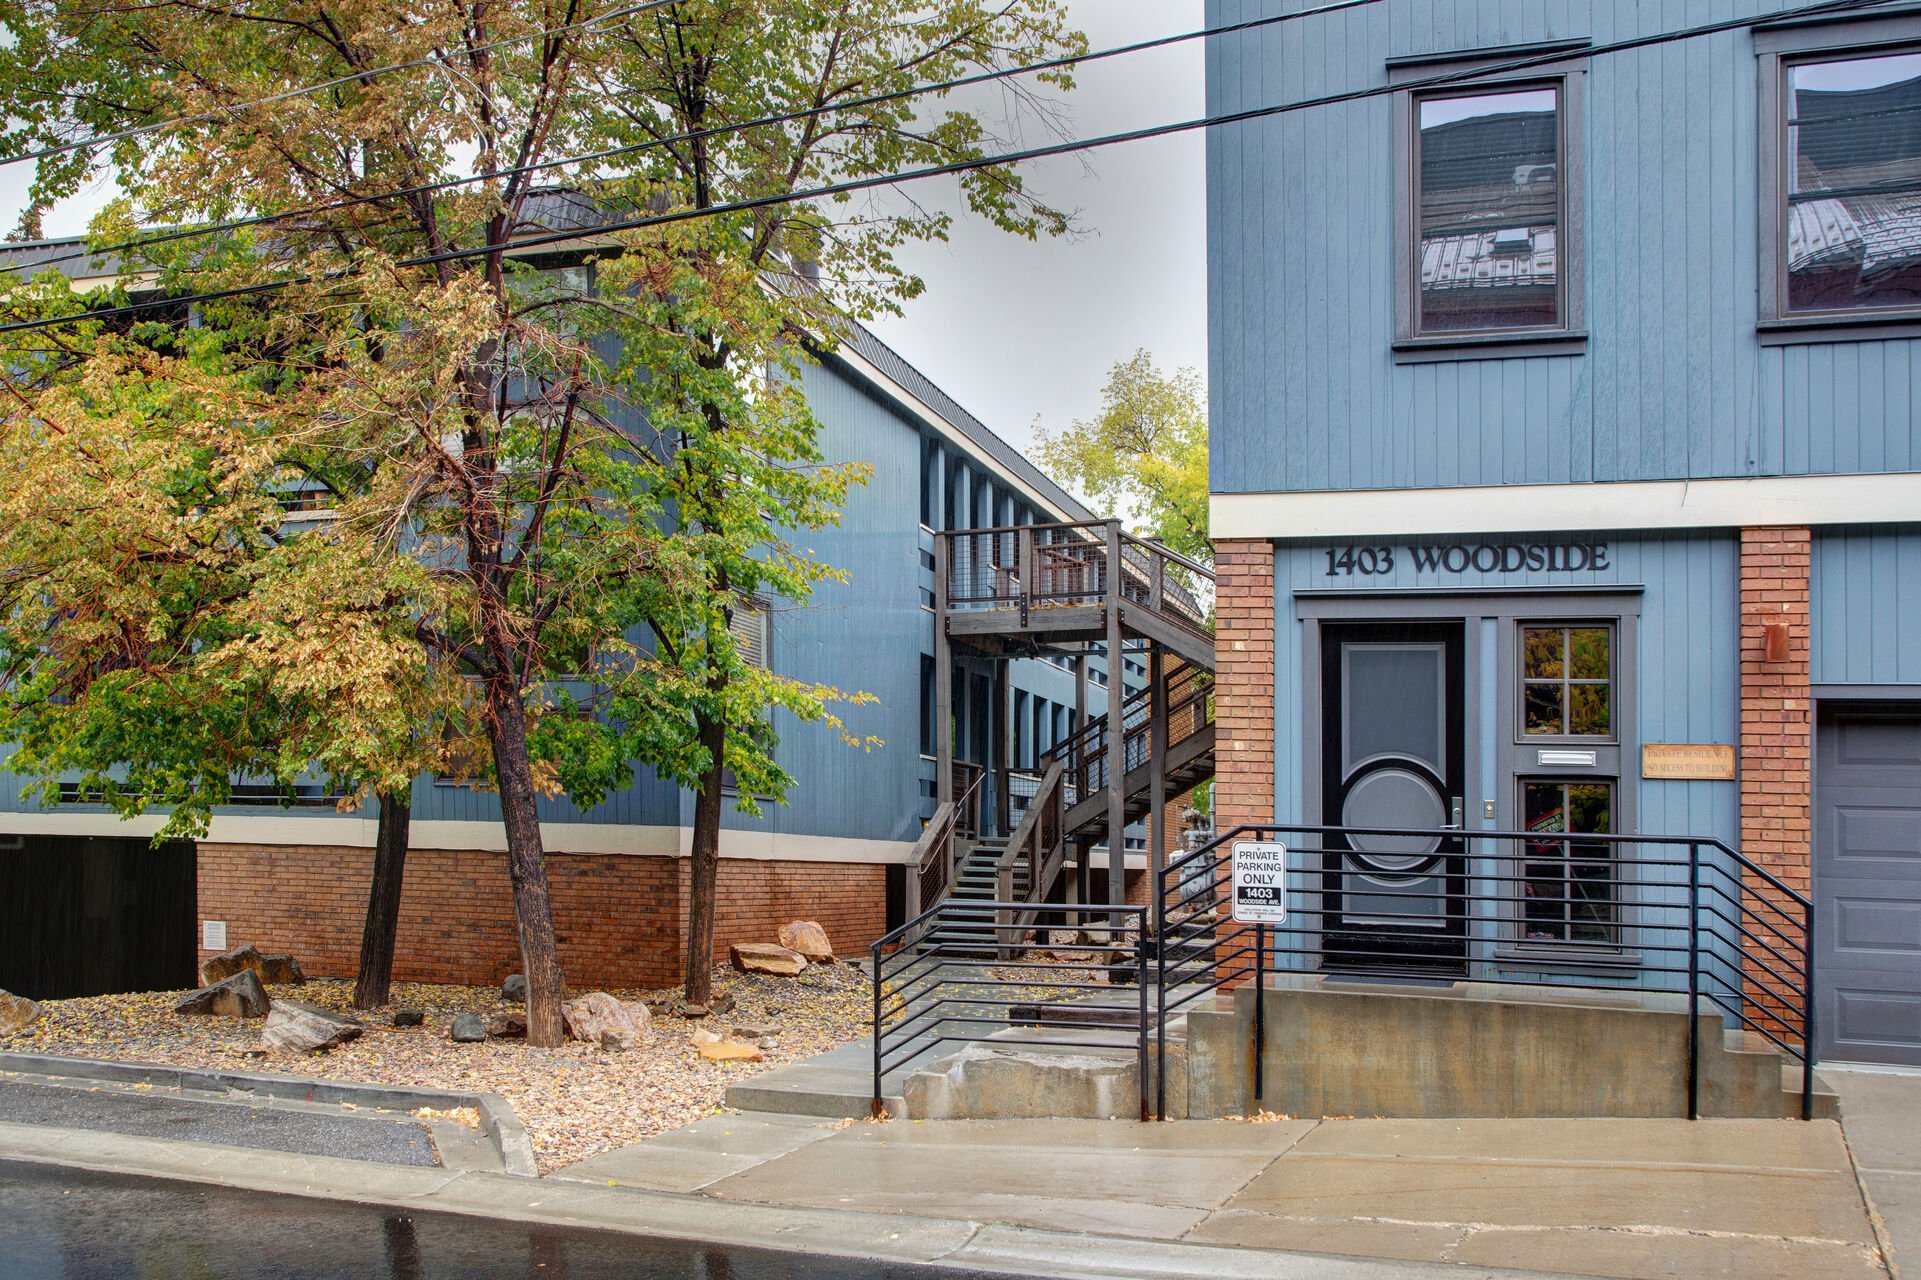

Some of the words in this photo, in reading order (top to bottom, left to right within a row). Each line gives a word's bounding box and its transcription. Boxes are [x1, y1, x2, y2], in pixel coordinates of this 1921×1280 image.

[1325, 546, 1394, 576] 1403
[1407, 543, 1610, 574] WOODSIDE
[1647, 749, 1681, 758] PRIVATE
[1683, 749, 1729, 759] RESIDENCE
[1239, 851, 1279, 860] PRIVATE
[1237, 862, 1281, 872] PARKING
[1243, 873, 1275, 884] ONLY
[1245, 888, 1273, 898] 1403
